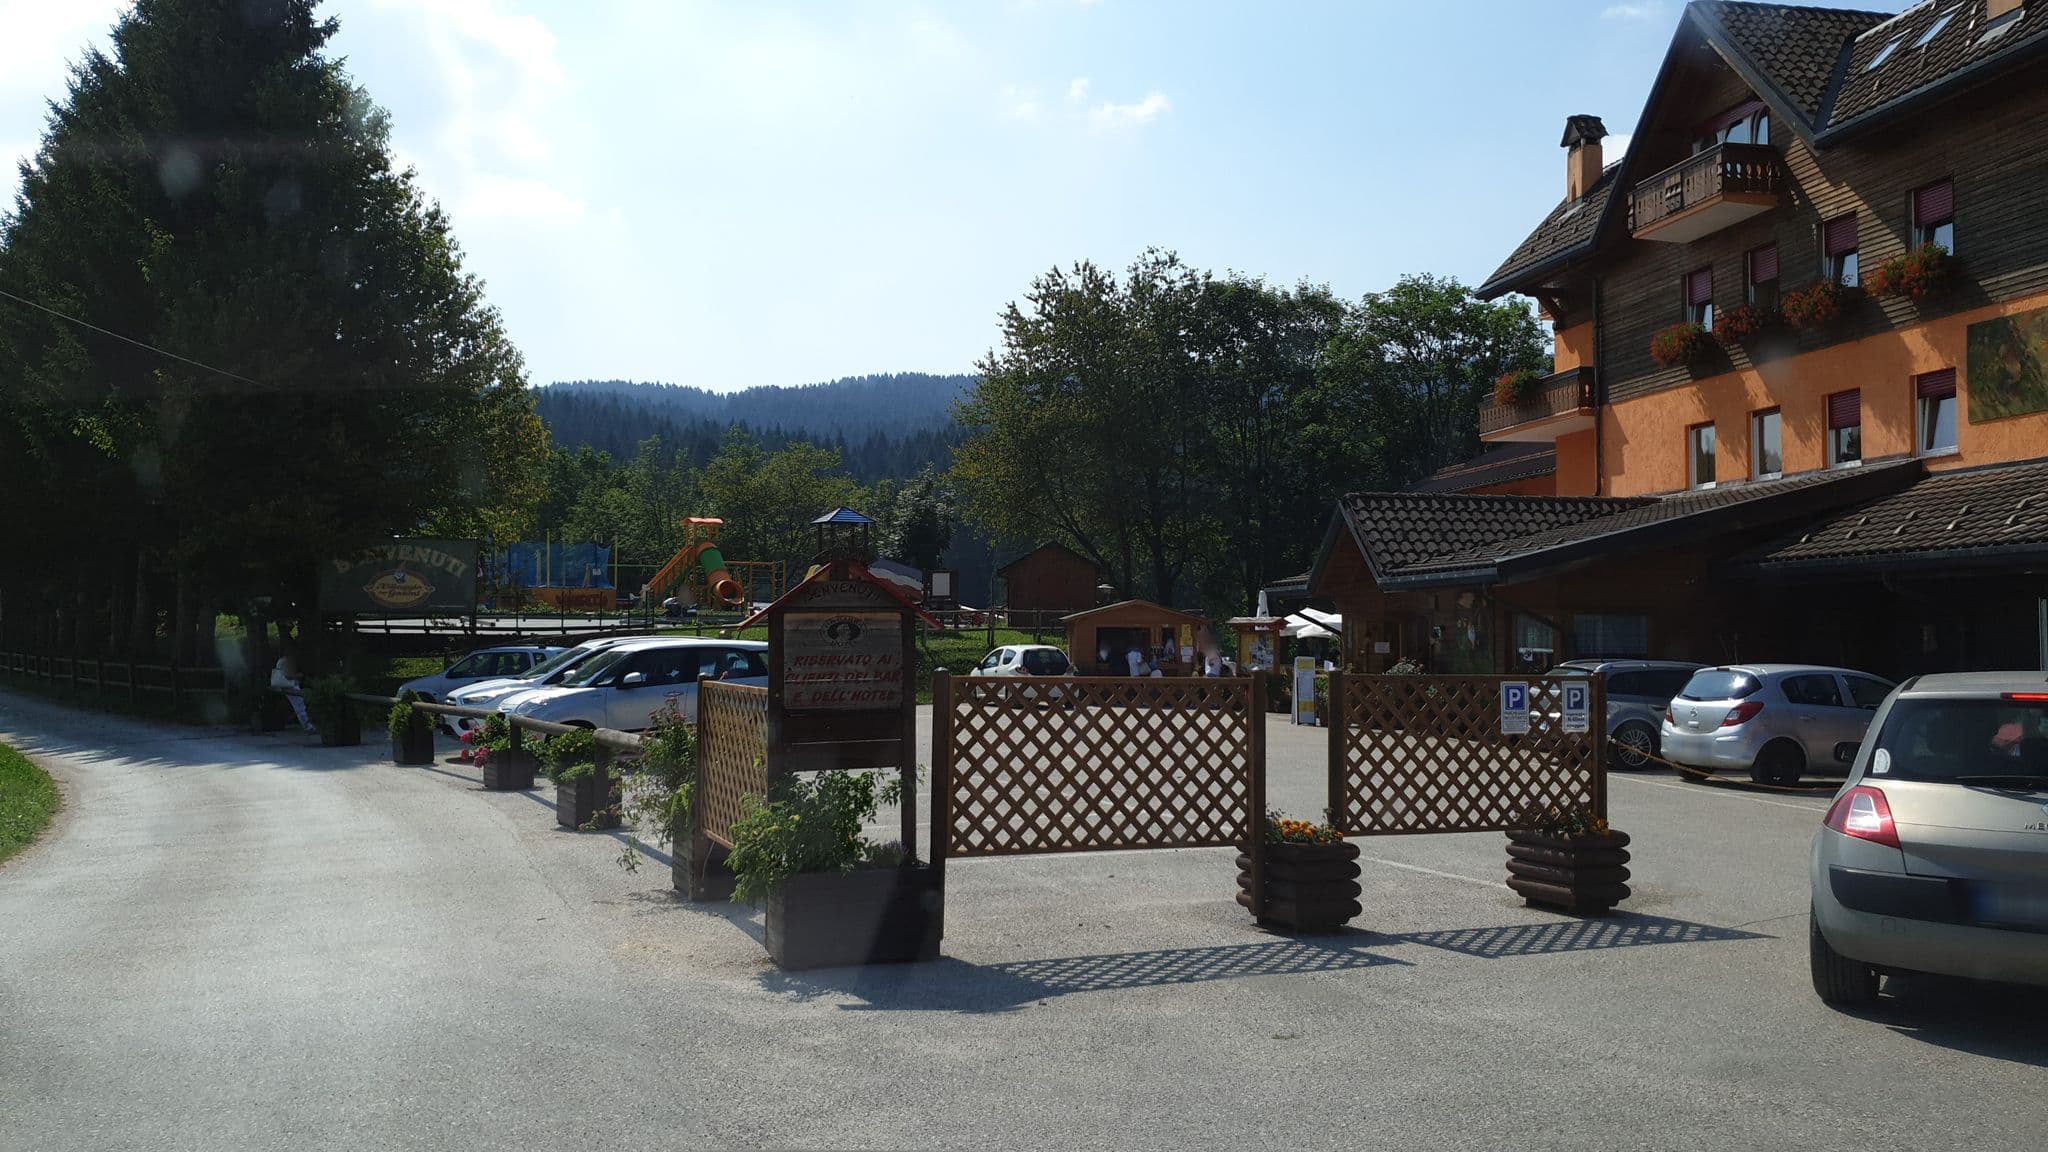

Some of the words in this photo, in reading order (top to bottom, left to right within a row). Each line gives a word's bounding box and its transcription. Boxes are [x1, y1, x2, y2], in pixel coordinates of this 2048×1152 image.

[794, 655, 872, 666] RISERVATO
[878, 654, 891, 666] AI
[1508, 689, 1521, 708] P
[1569, 689, 1582, 708] P
